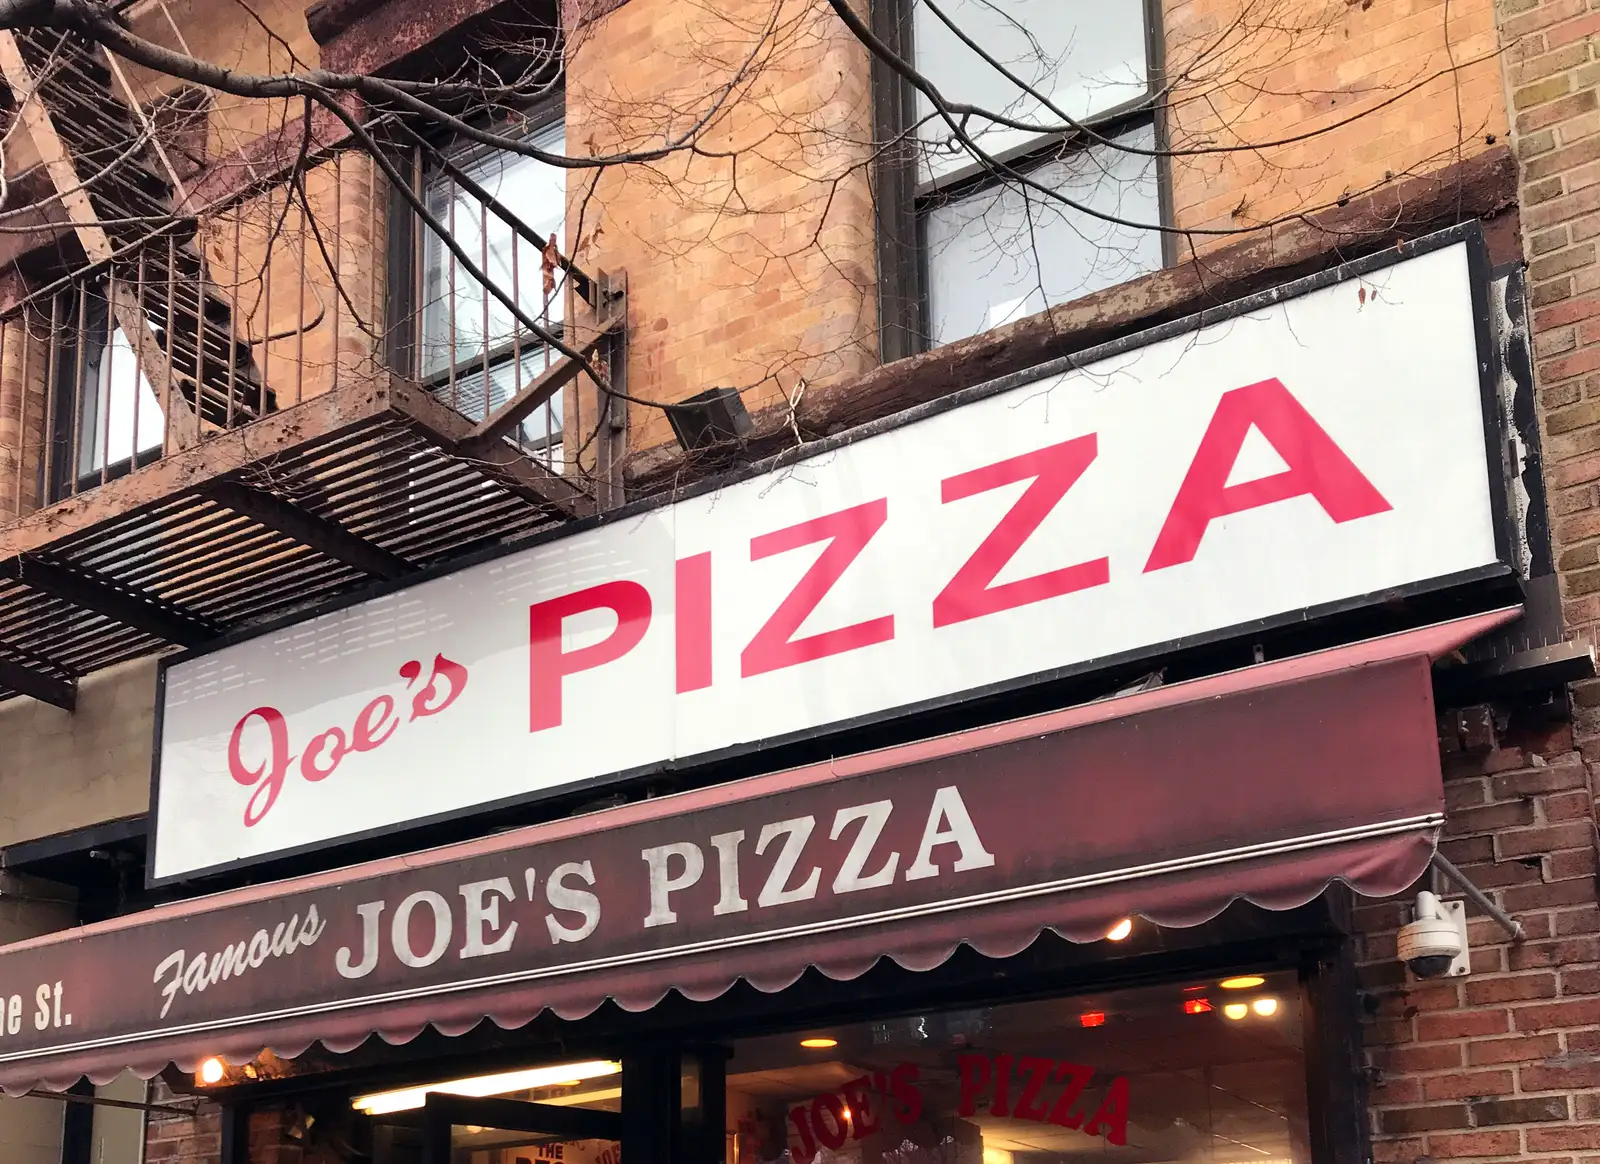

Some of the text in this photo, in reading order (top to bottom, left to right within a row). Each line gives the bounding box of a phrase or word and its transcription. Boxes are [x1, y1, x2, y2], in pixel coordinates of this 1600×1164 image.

[227, 376, 1394, 827] Joe's PIZZA
[153, 785, 995, 1019] Famous JOE'S PIZZA
[34, 979, 72, 1031] St.
[787, 1053, 1131, 1164] JOE'S PIZZA
